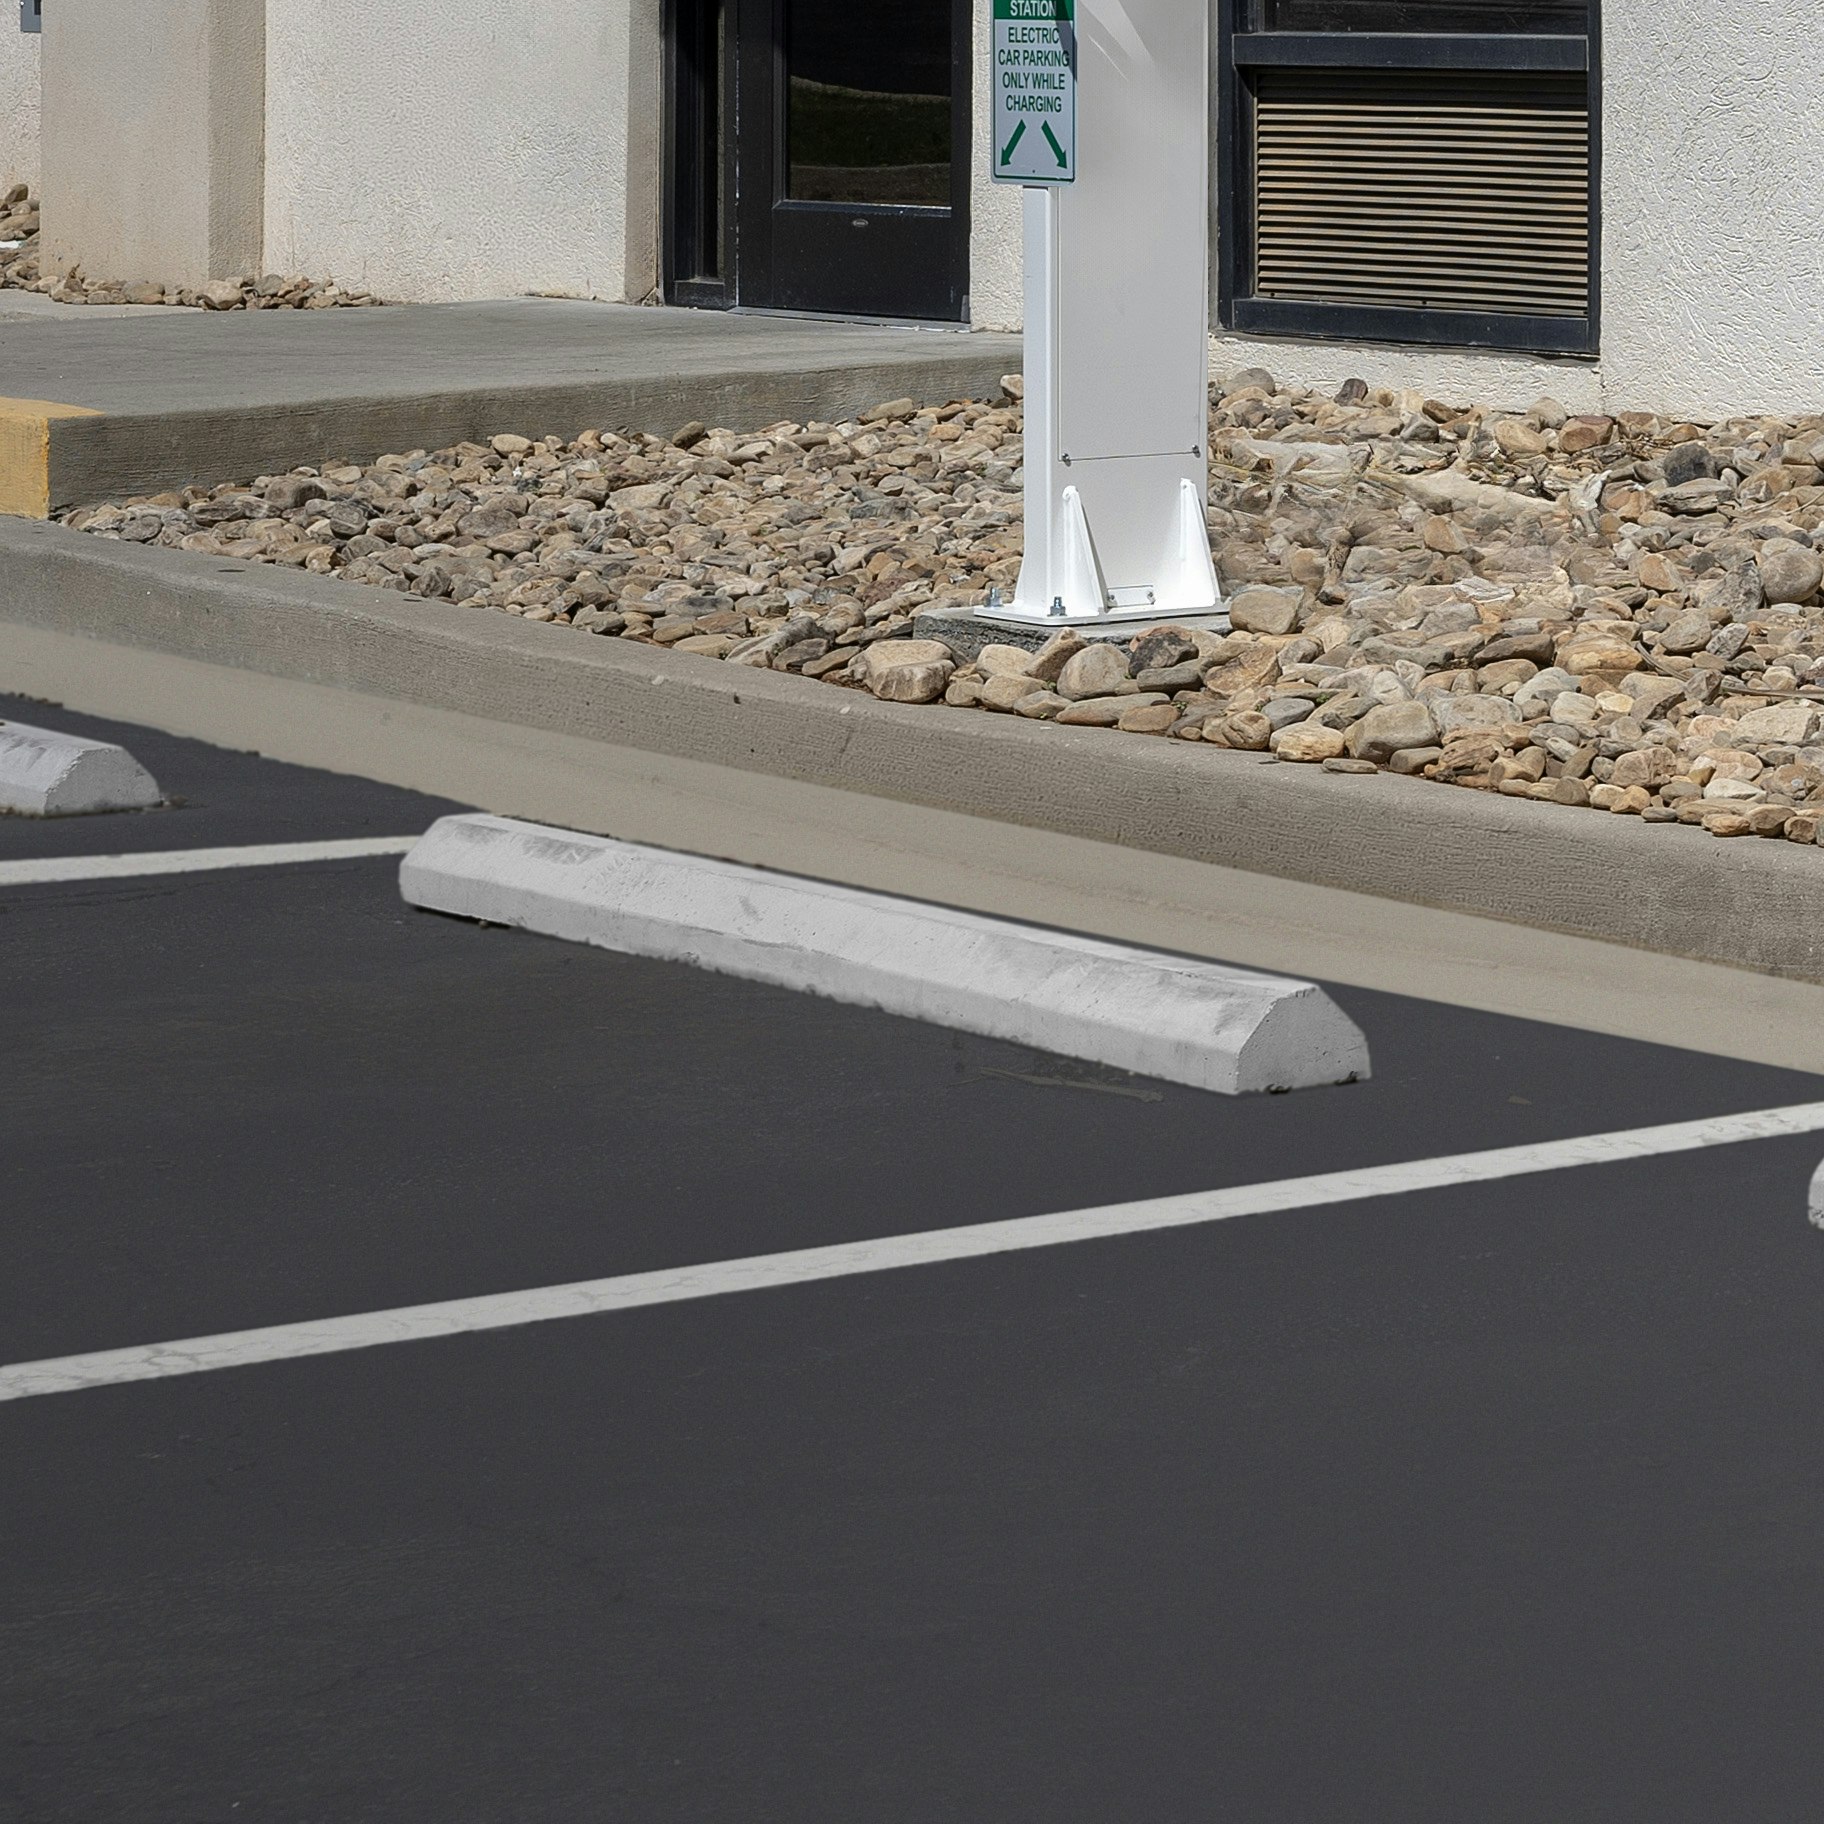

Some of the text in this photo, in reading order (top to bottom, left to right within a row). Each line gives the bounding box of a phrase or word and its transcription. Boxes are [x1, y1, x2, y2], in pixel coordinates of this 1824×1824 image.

[1010, 0, 1057, 17] STATION
[1008, 26, 1060, 44] ELECTRIC
[998, 49, 1070, 67] CAR PARKING
[1002, 71, 1066, 90] ONLY WHILE
[1006, 94, 1062, 113] CHARGING
